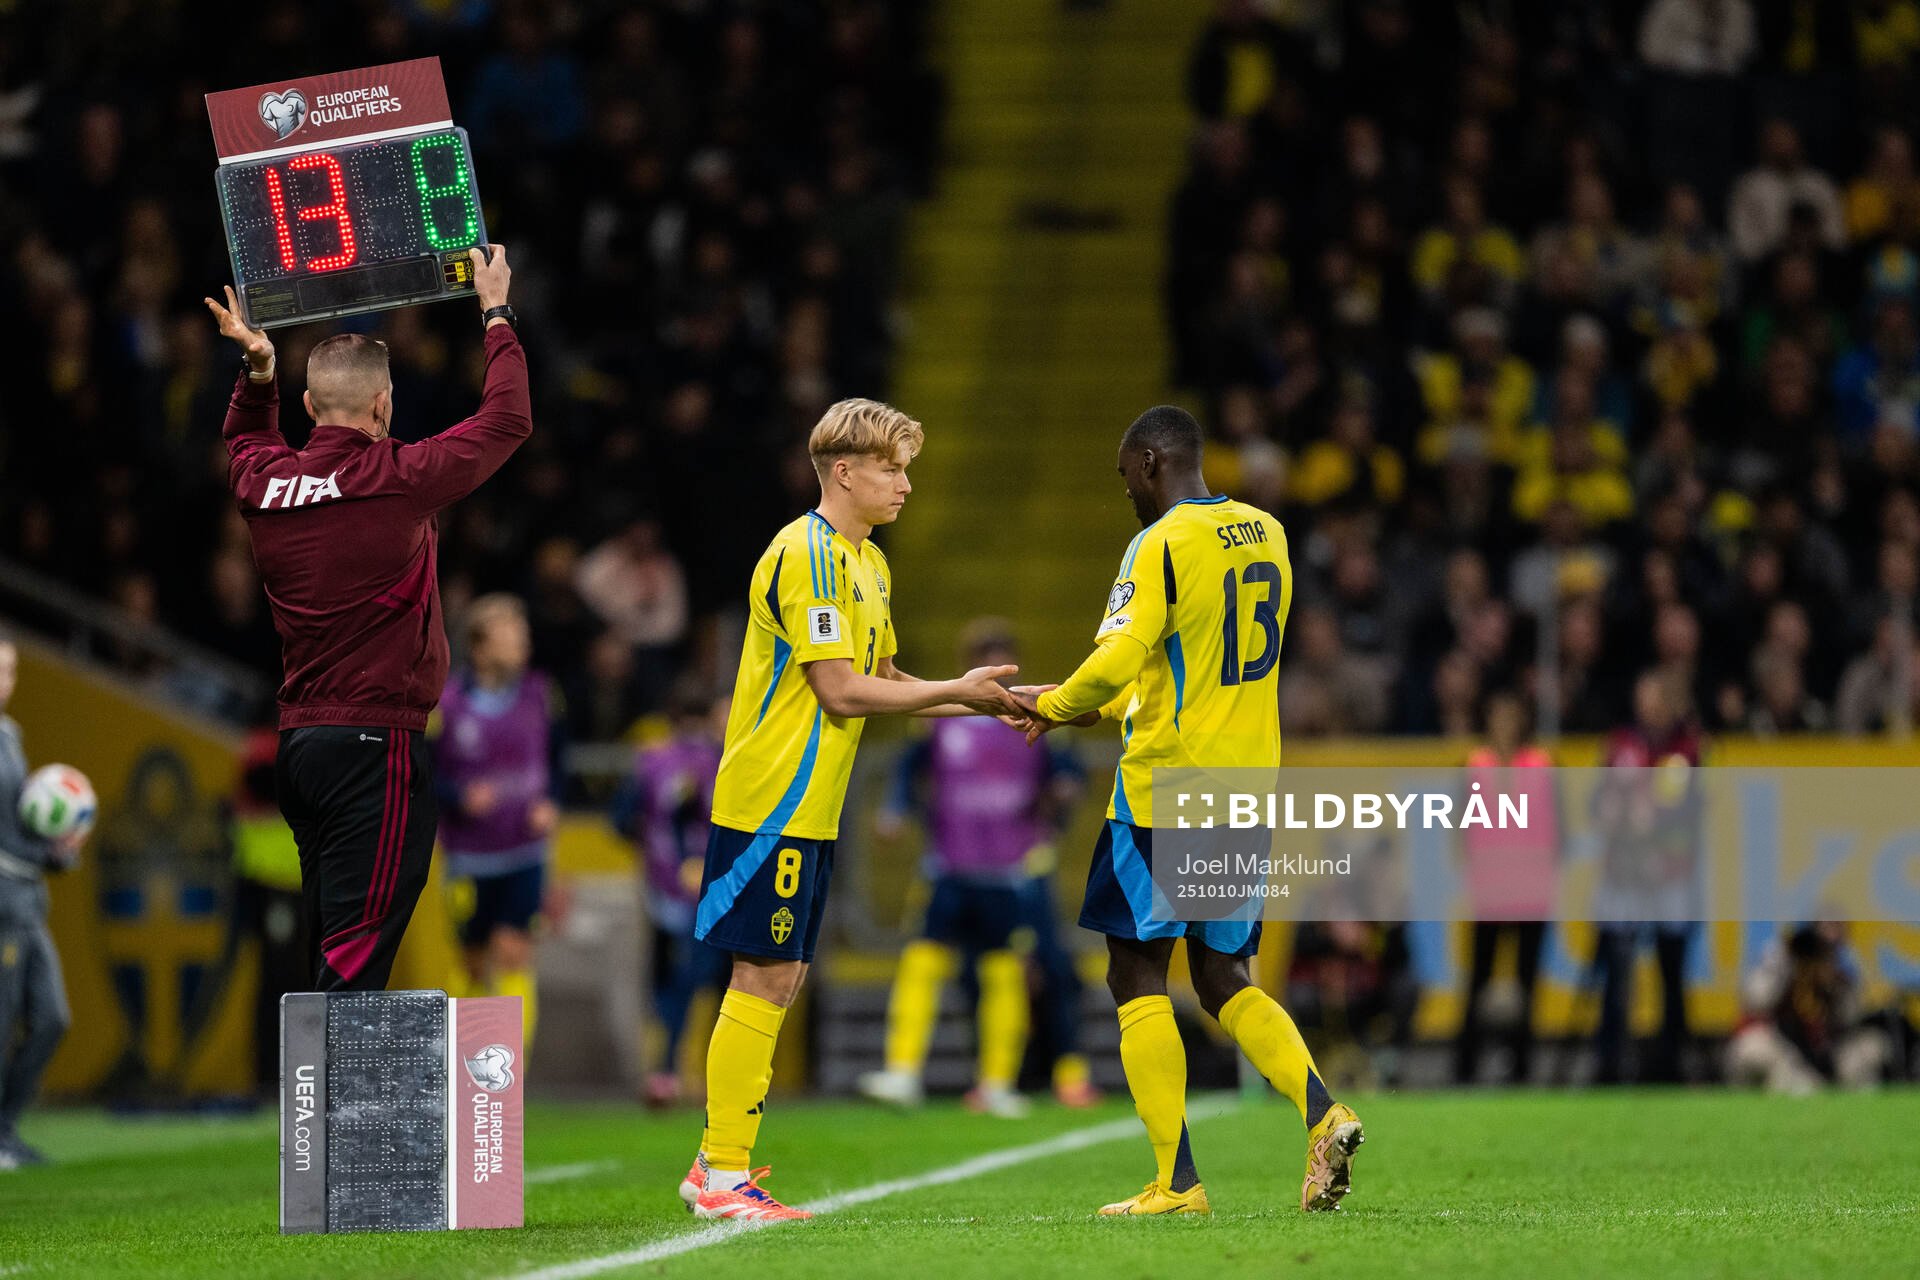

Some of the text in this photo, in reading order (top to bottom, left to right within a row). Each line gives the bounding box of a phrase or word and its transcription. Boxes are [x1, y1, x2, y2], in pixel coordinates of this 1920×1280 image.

[310, 97, 402, 127] QUALIFIERS
[316, 85, 390, 108] EUROPEAN
[265, 153, 358, 272] 13
[410, 133, 479, 251] 8
[260, 471, 343, 509] FIFA
[1216, 520, 1268, 550] SEMA
[1221, 561, 1282, 687] 13
[774, 848, 803, 899] 8
[295, 1065, 315, 1171] UEFA.com
[471, 1092, 489, 1184] QUALIFIERS
[489, 1101, 503, 1174] EUROPEAN
